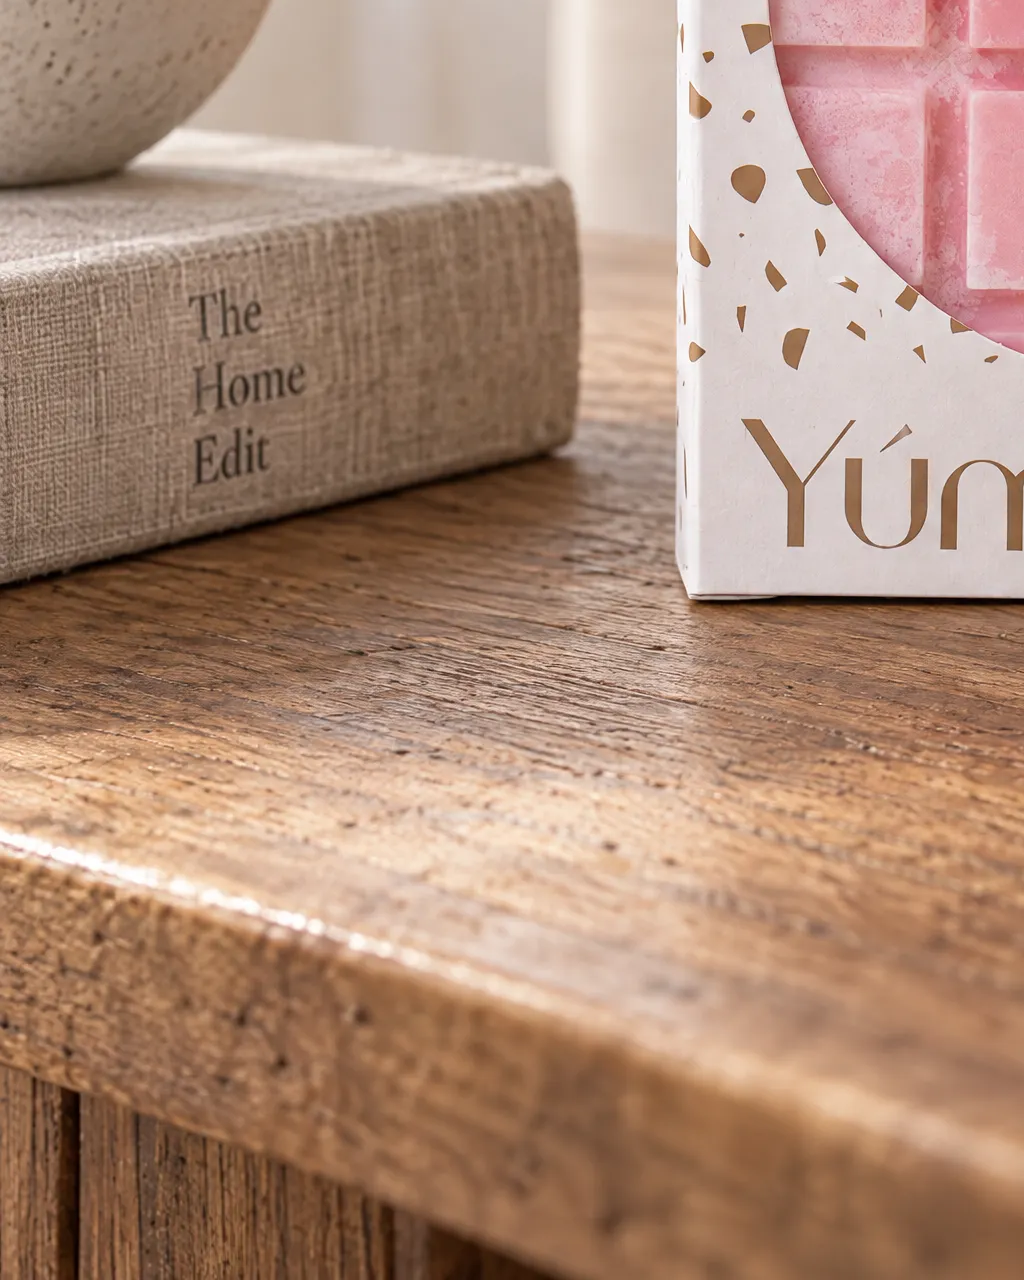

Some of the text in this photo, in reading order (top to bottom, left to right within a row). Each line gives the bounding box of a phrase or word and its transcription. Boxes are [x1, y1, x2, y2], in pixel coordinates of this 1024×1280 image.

[188, 287, 263, 344] The
[191, 361, 307, 417] Home
[191, 427, 270, 488] Edit
